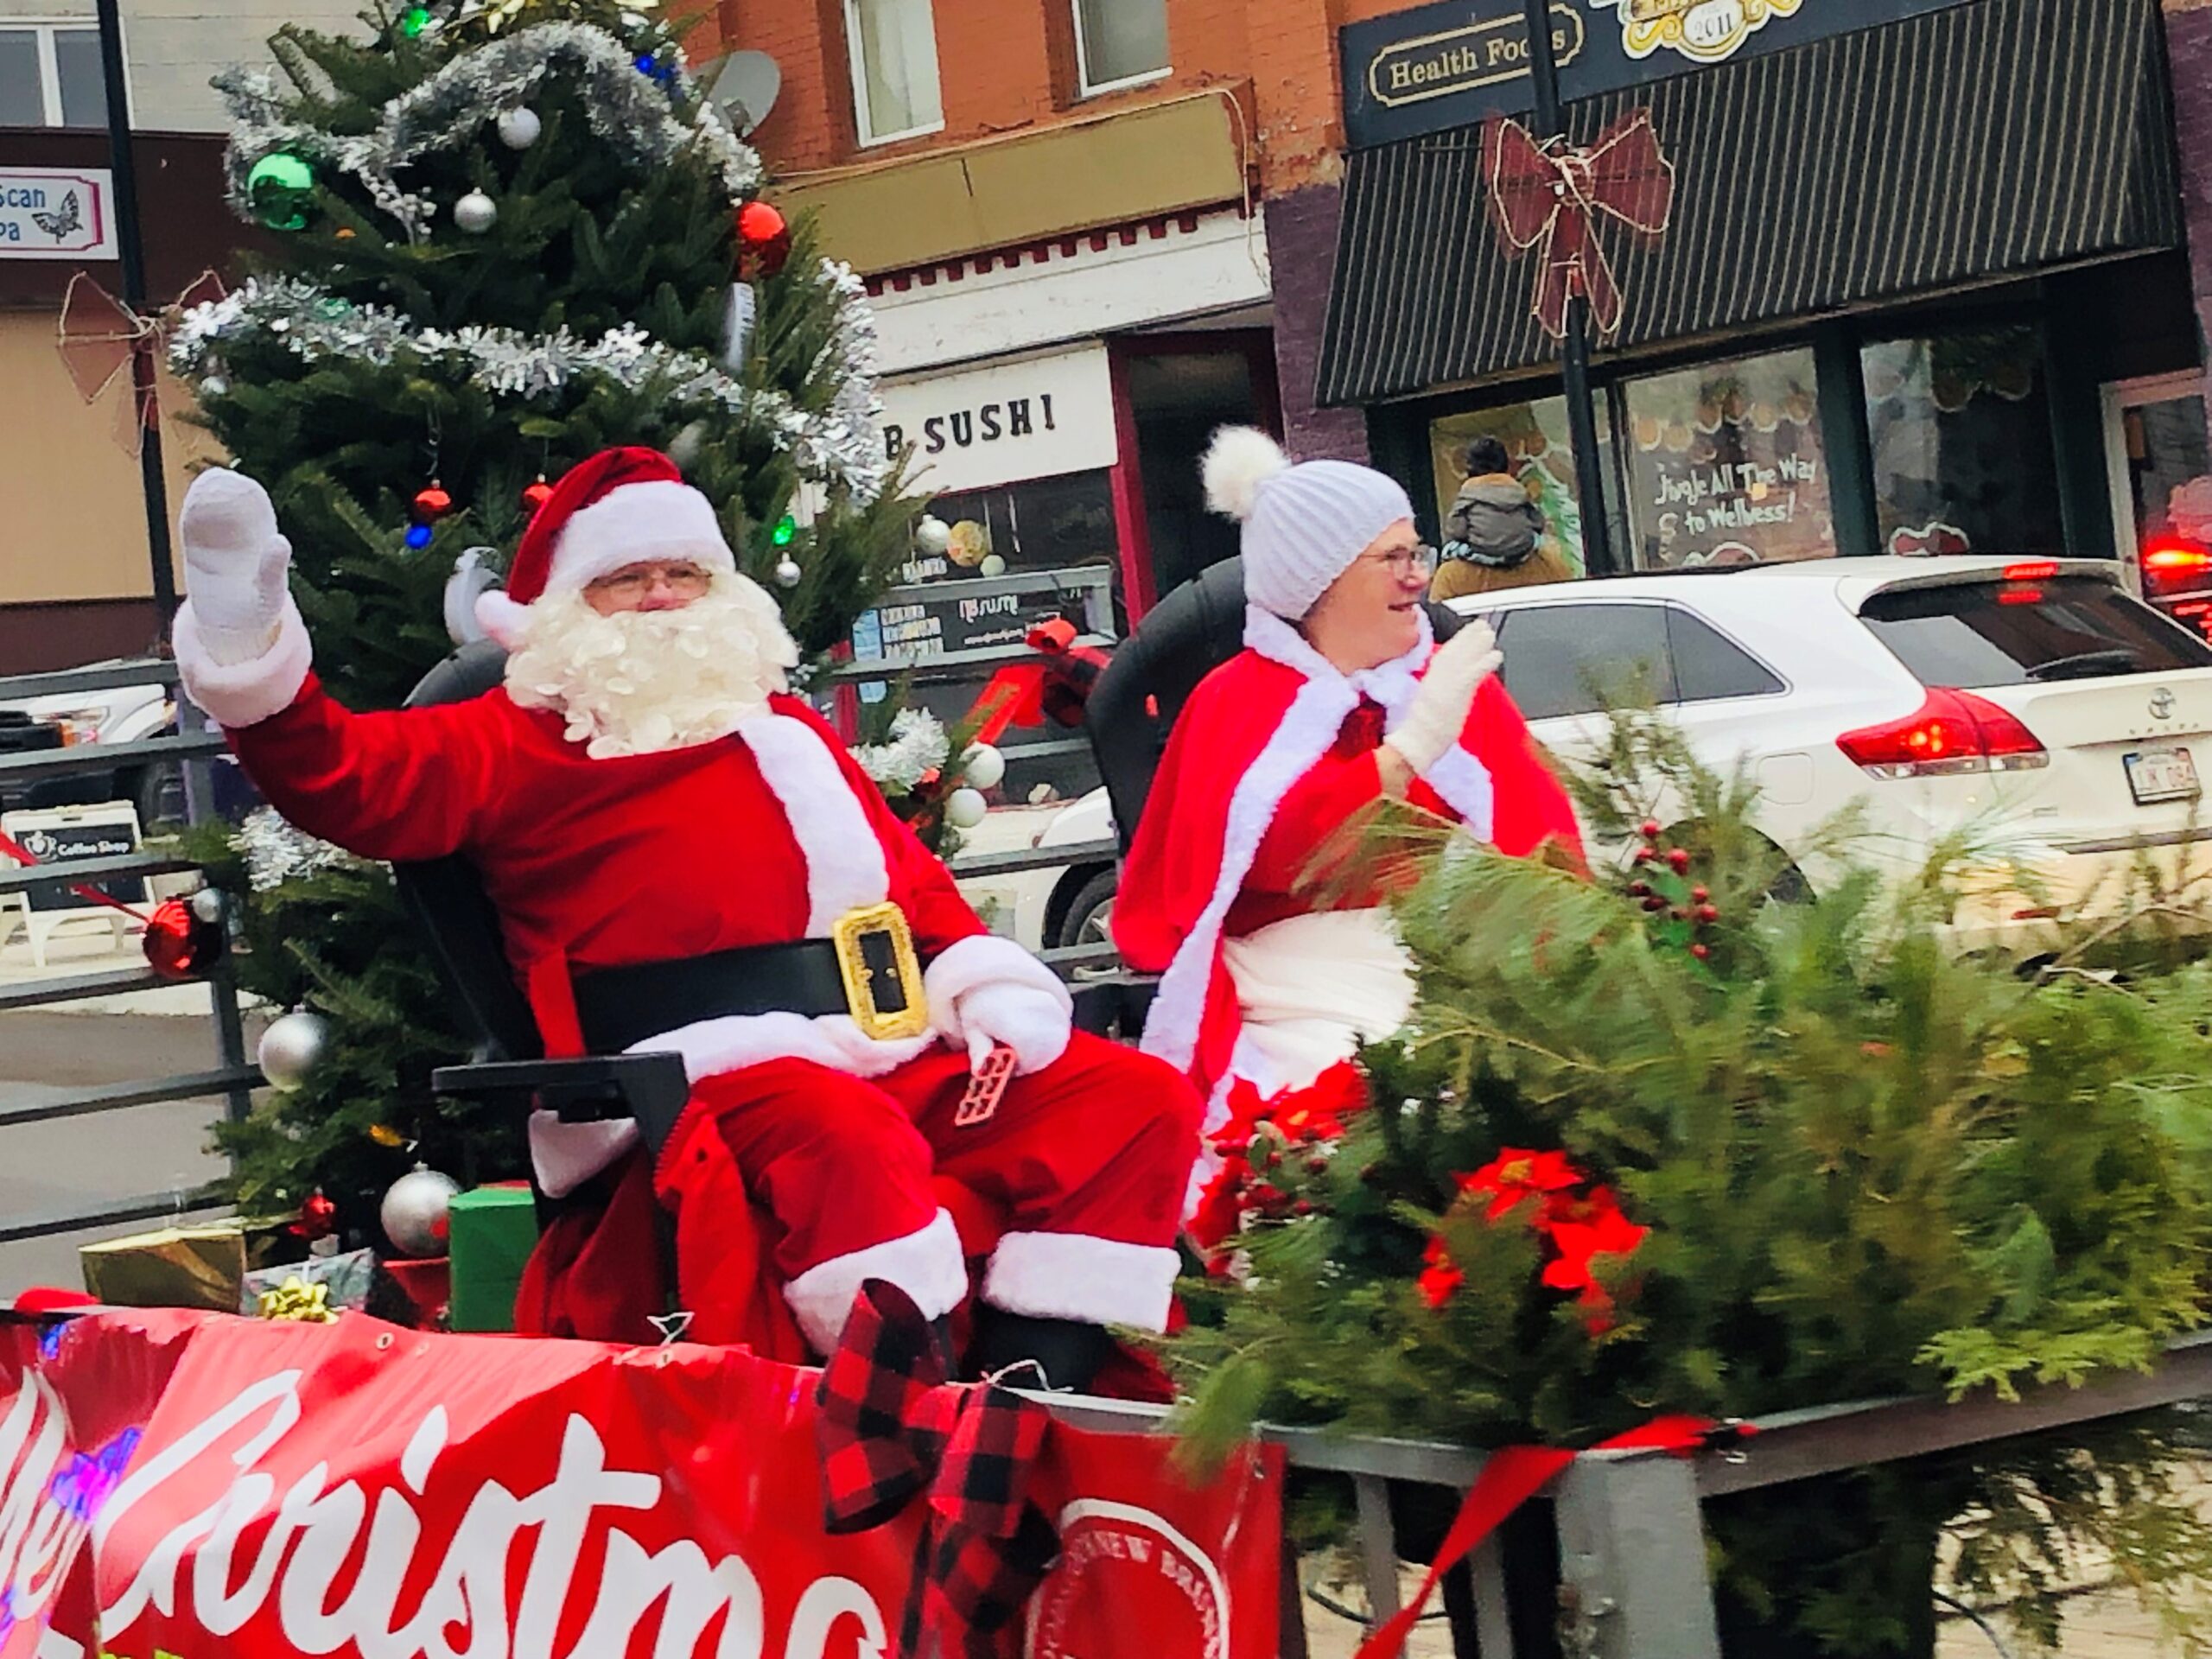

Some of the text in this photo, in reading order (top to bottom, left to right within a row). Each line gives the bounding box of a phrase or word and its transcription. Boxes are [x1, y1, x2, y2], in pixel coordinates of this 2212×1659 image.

[1694, 12, 1734, 41] 2011
[1389, 29, 1567, 89] Health Foos
[924, 394, 1056, 454] SUSHI
[1710, 463, 1735, 496] All
[1736, 461, 1777, 494] The
[1777, 452, 1817, 485] Way
[1684, 510, 1706, 536] to
